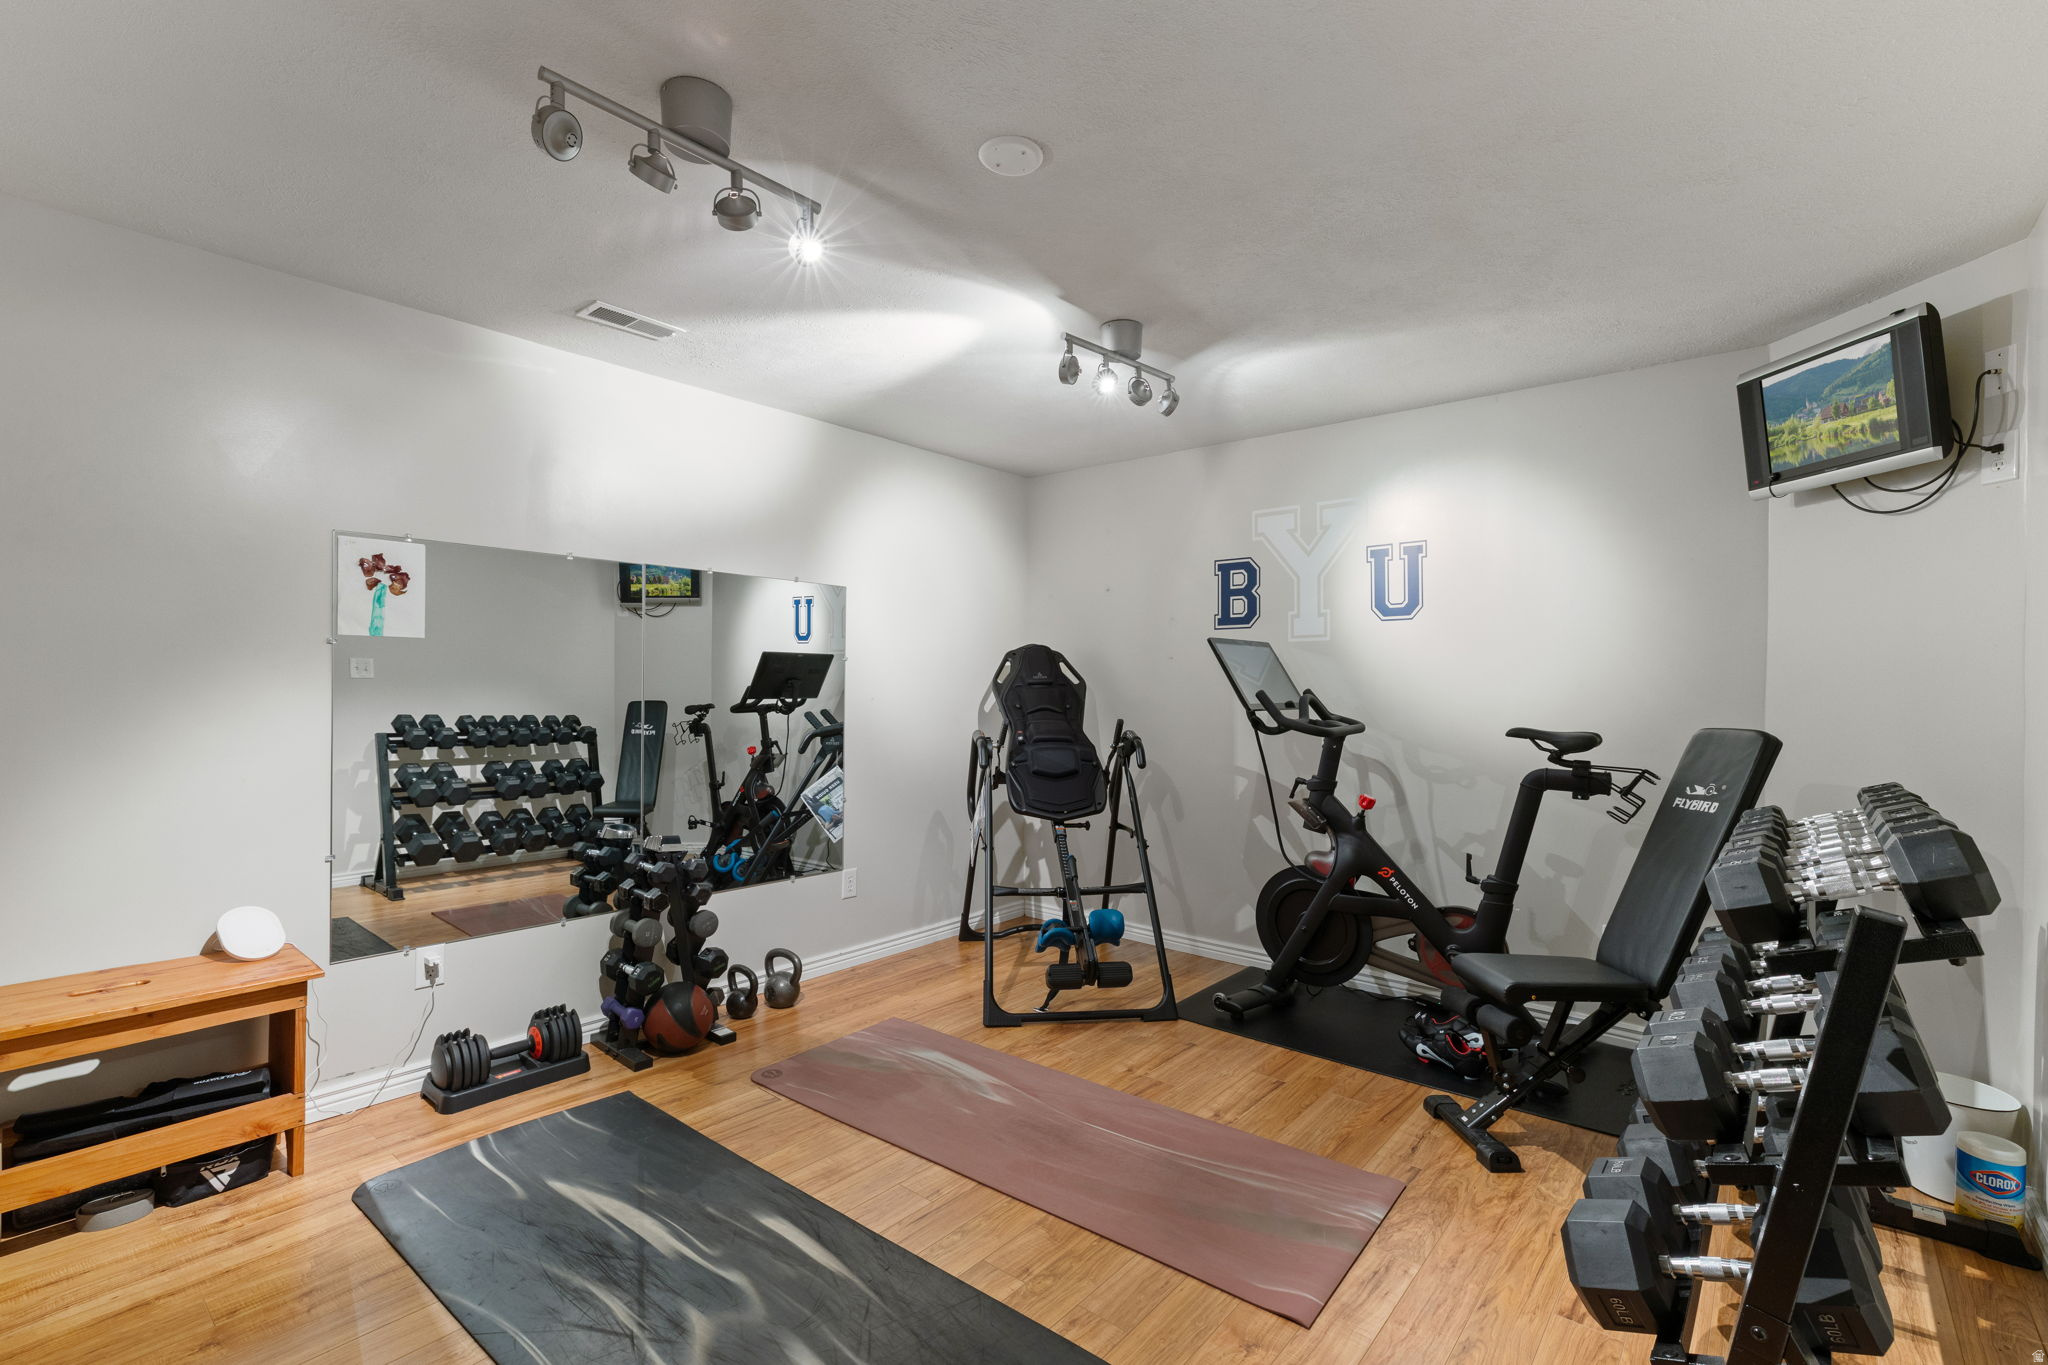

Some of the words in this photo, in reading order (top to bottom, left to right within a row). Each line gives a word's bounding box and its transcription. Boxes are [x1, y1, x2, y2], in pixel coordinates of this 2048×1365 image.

[1672, 797, 1720, 814] FLYBIRD
[1388, 876, 1419, 910] PELOTON
[1975, 1172, 2017, 1191] CLOROX
[1609, 1297, 1634, 1326] 60LB
[1818, 1313, 1845, 1344] 60LB
